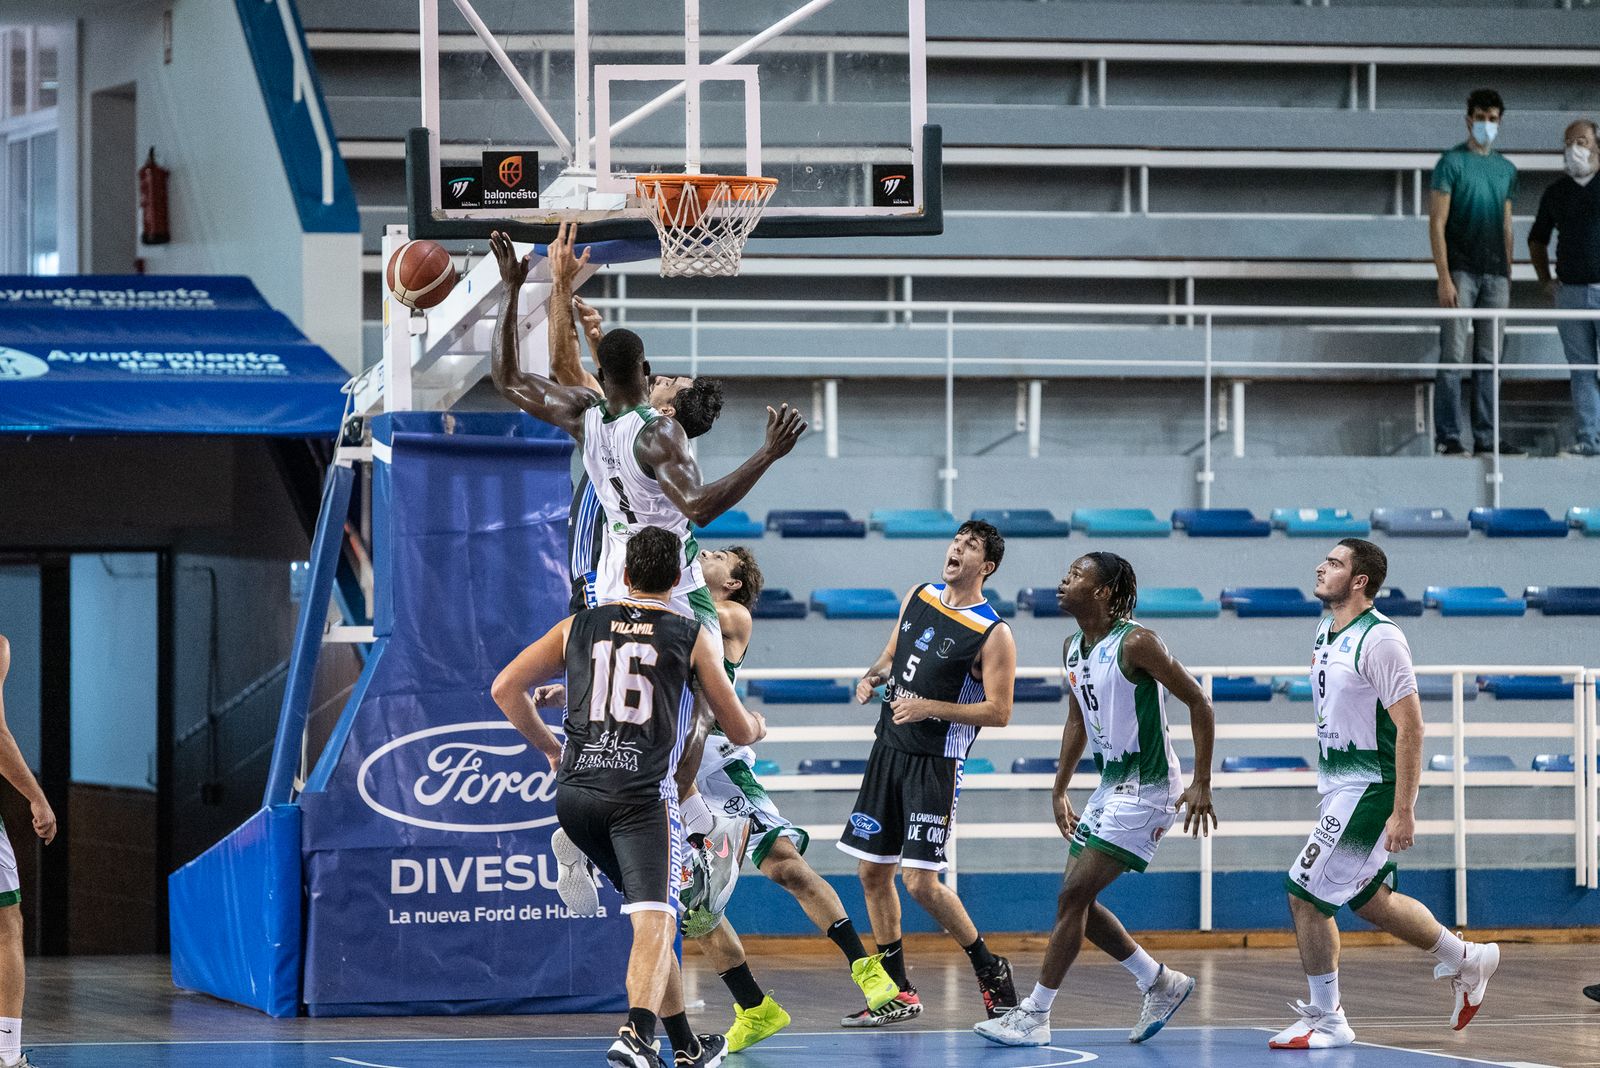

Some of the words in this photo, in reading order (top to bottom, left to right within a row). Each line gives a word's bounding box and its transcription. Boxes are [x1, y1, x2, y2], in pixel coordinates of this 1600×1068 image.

[484, 189, 538, 199] baloncesto
[0, 288, 209, 301] yuntamiento
[47, 350, 281, 363] Ayuntamiento
[118, 360, 160, 370] de
[168, 360, 287, 371] Huelva
[610, 620, 655, 636] VILLAMIL
[902, 653, 921, 682] 5
[589, 639, 658, 726] 16
[1318, 670, 1326, 698] 9
[1080, 683, 1099, 711] 15
[907, 824, 923, 841] DE
[926, 826, 945, 844] ORO
[1315, 827, 1336, 844] OYOTA
[1300, 842, 1321, 869] 9
[389, 909, 411, 924] La
[415, 908, 471, 923] nueva
[474, 905, 515, 922] Ford
[519, 905, 542, 920] de
